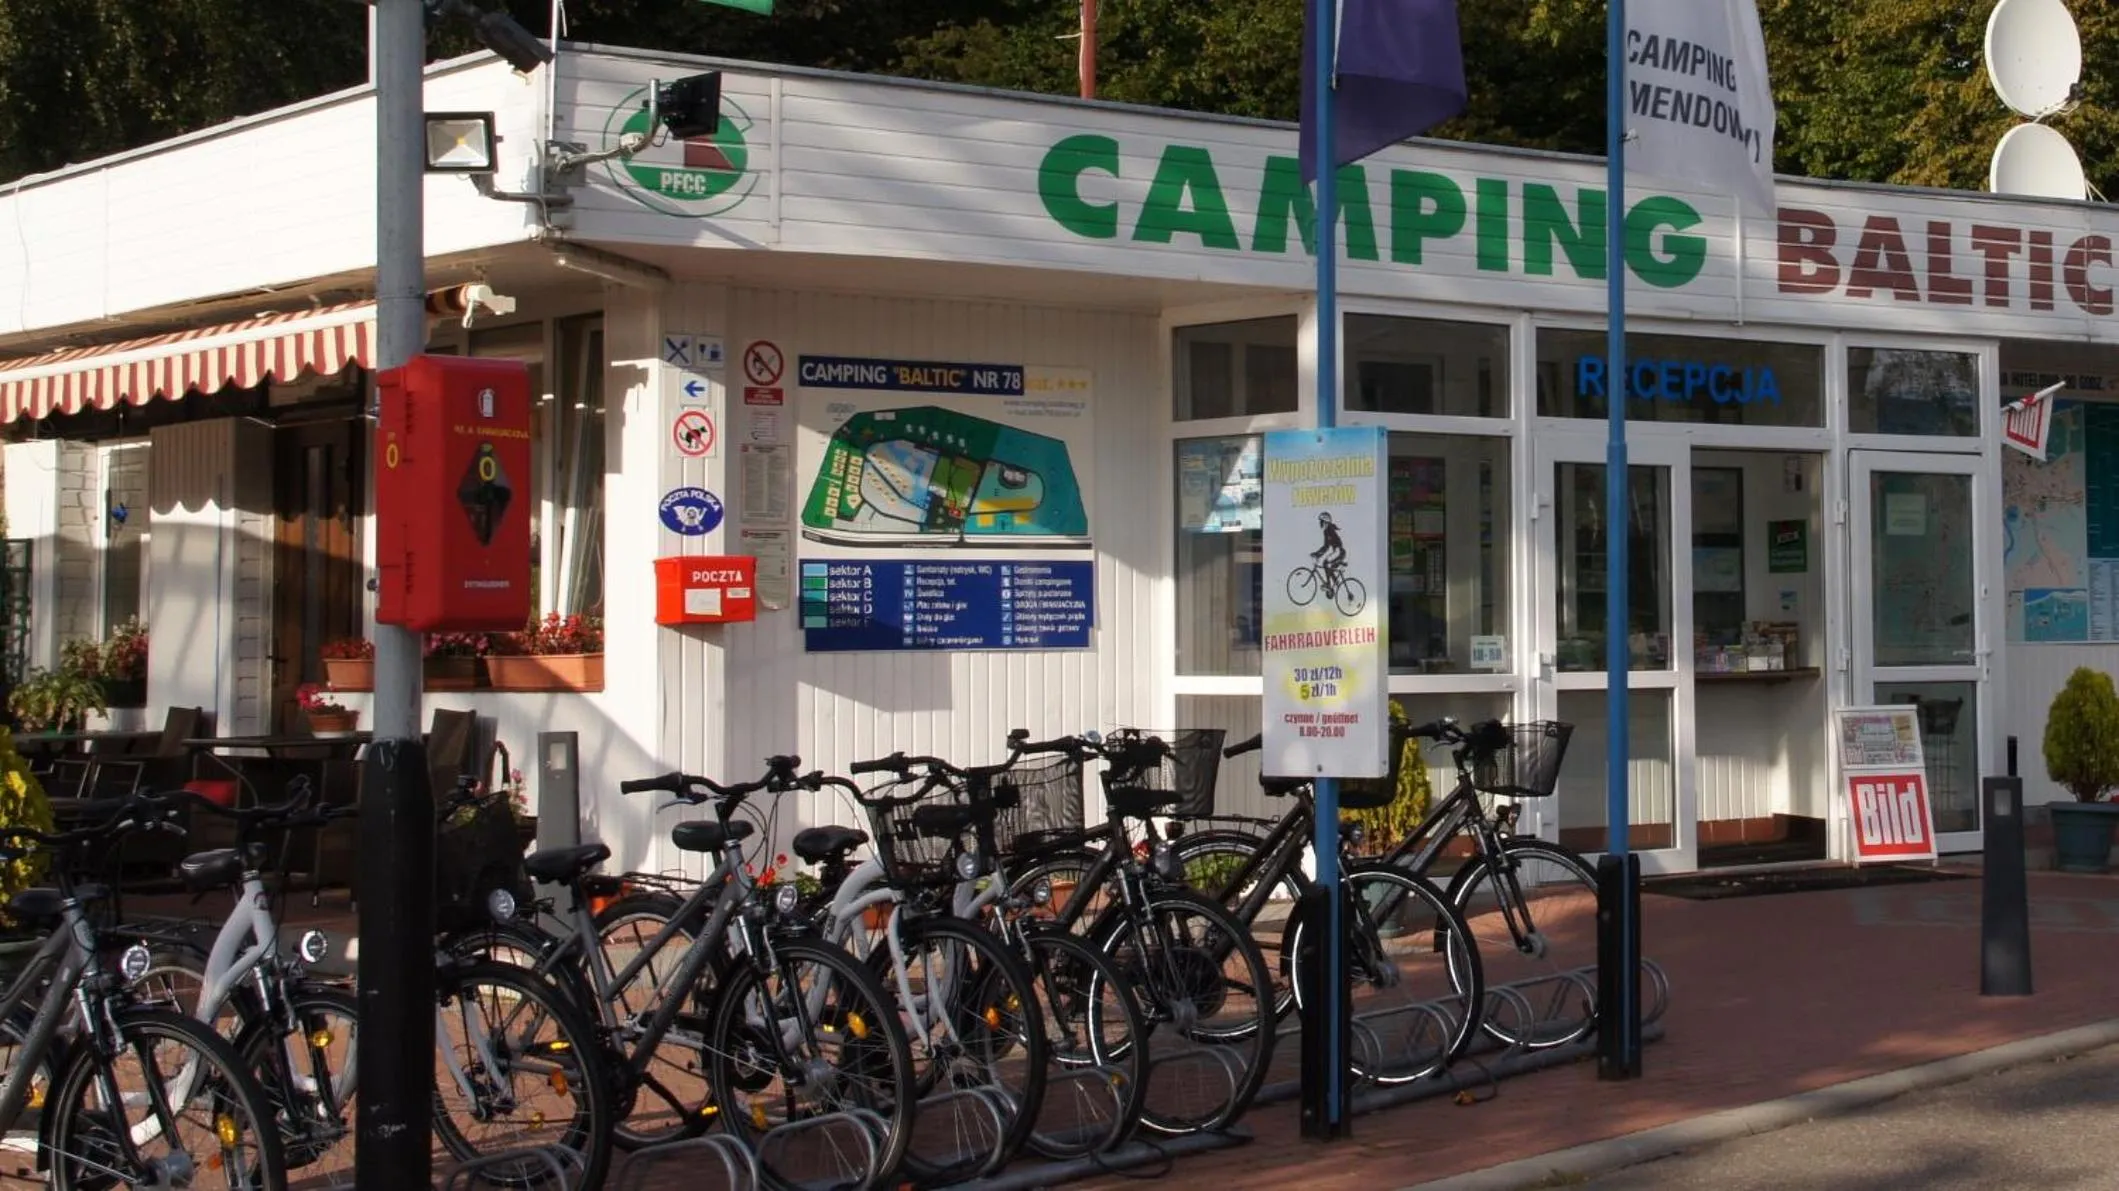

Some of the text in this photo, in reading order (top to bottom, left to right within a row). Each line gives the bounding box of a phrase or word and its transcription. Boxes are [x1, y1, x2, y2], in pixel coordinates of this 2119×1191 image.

[1627, 29, 1737, 92] CAMPING
[659, 171, 707, 195] PFCC
[1037, 133, 1707, 289] CAMPING
[1777, 207, 2115, 316] BALTIC
[801, 362, 887, 385] CAMPING
[893, 366, 967, 388] "BALTIC"
[973, 369, 999, 390] NR
[1003, 371, 1021, 391] 78
[1578, 354, 1783, 407] RCEPCJA
[1266, 454, 1375, 484] Wypożyczalnia
[660, 489, 721, 512] POCZTA POLSKA
[692, 570, 743, 583] POCZTA
[829, 565, 873, 576] sektor A
[829, 577, 873, 589] sektor B
[829, 590, 873, 602] sektor C
[863, 603, 873, 615] D
[1264, 627, 1376, 652] FAHRRADVERLEIH
[1294, 665, 1343, 683] 30 zł/12h
[1300, 683, 1337, 700] 5 zł/1h
[1284, 713, 1315, 724] czynne
[1855, 782, 1924, 846] Bild
